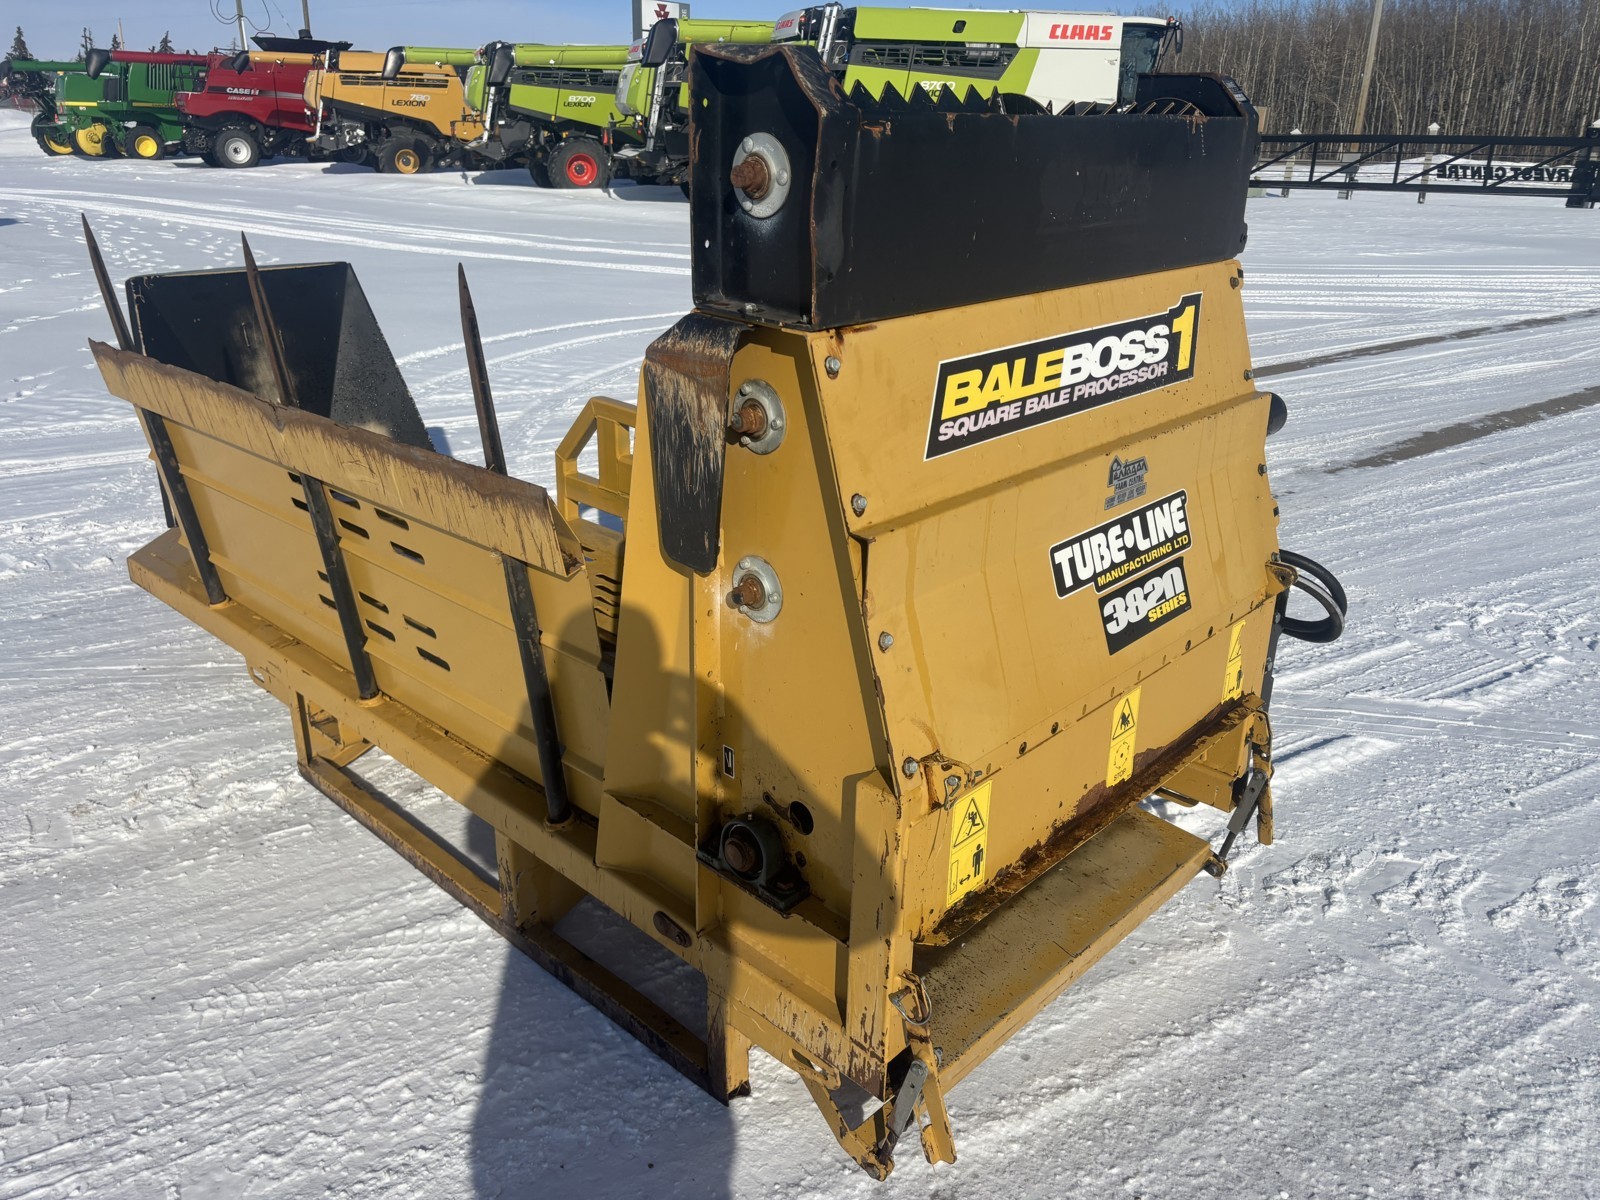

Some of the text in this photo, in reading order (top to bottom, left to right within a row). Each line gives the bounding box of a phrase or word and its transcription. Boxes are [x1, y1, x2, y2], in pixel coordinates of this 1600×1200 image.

[1049, 24, 1113, 40] CLAAS
[226, 86, 250, 95] CASE
[391, 99, 426, 107] LEXION
[568, 95, 596, 103] 8700
[1172, 304, 1196, 372] 1
[938, 361, 1169, 441] SQUARE BALE PROCESSOR
[1098, 535, 1189, 586] MANUFACTURING LTD
[1148, 592, 1187, 623] SERIES
[1113, 767, 1127, 782] STOP
